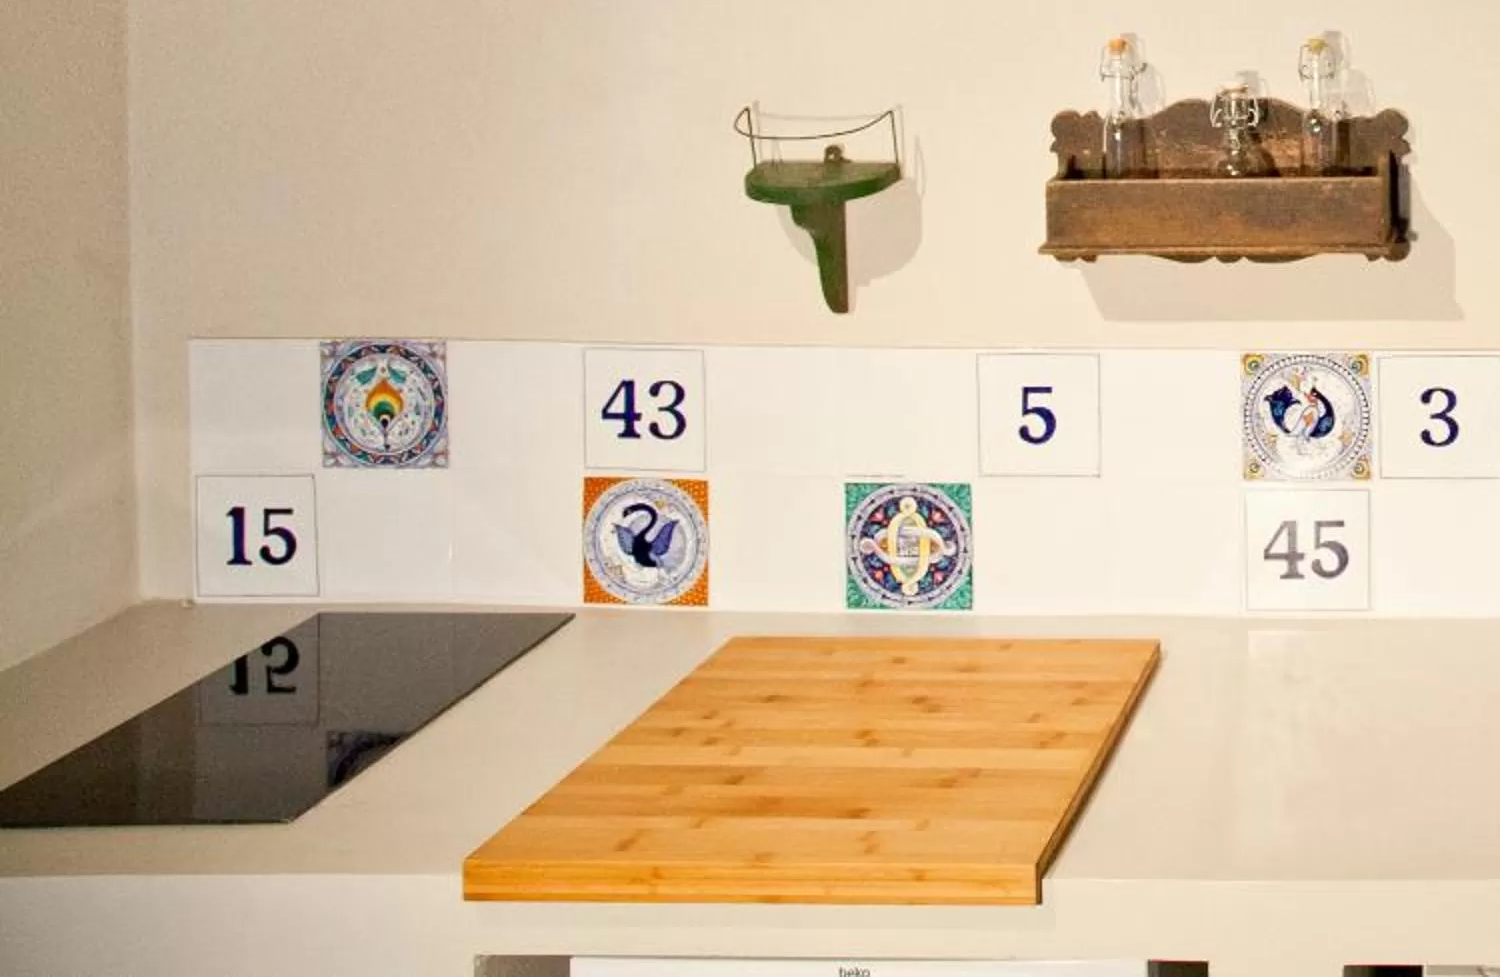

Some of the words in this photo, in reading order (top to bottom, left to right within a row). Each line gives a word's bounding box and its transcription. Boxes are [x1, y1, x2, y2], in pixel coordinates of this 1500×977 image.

[601, 379, 687, 440] 43
[1018, 386, 1057, 445] 5
[1420, 387, 1460, 448] 3
[225, 505, 298, 566] 15
[1263, 520, 1349, 579] 45
